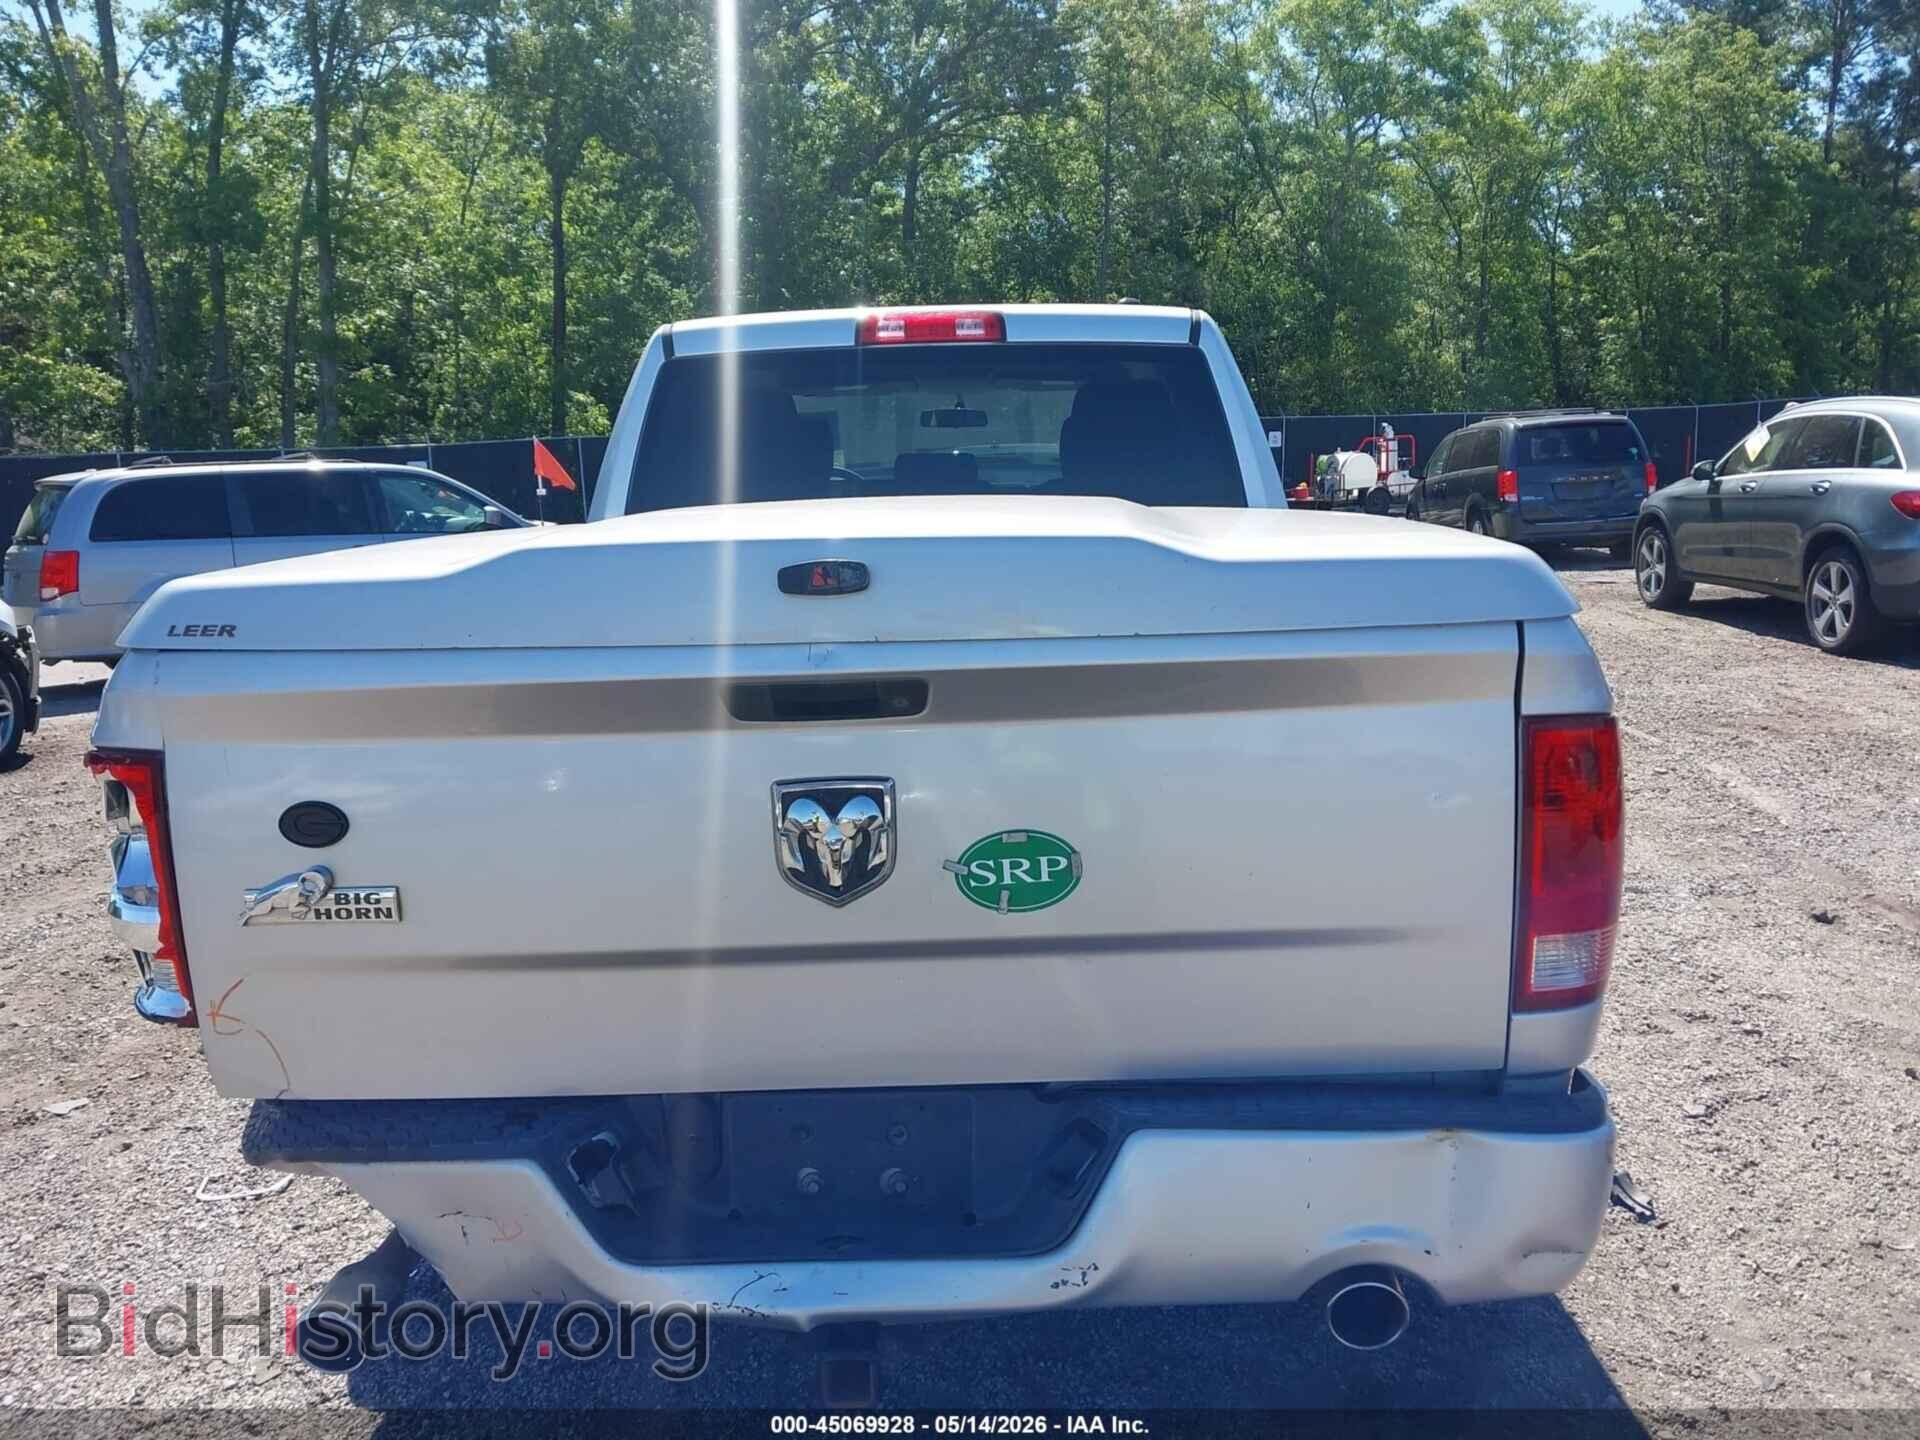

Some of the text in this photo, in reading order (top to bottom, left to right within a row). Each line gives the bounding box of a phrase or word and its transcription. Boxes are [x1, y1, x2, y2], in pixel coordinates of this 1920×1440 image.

[167, 624, 237, 637] LEER
[969, 855, 1068, 887] SRP
[334, 892, 382, 905] BIG
[314, 907, 393, 920] HORN
